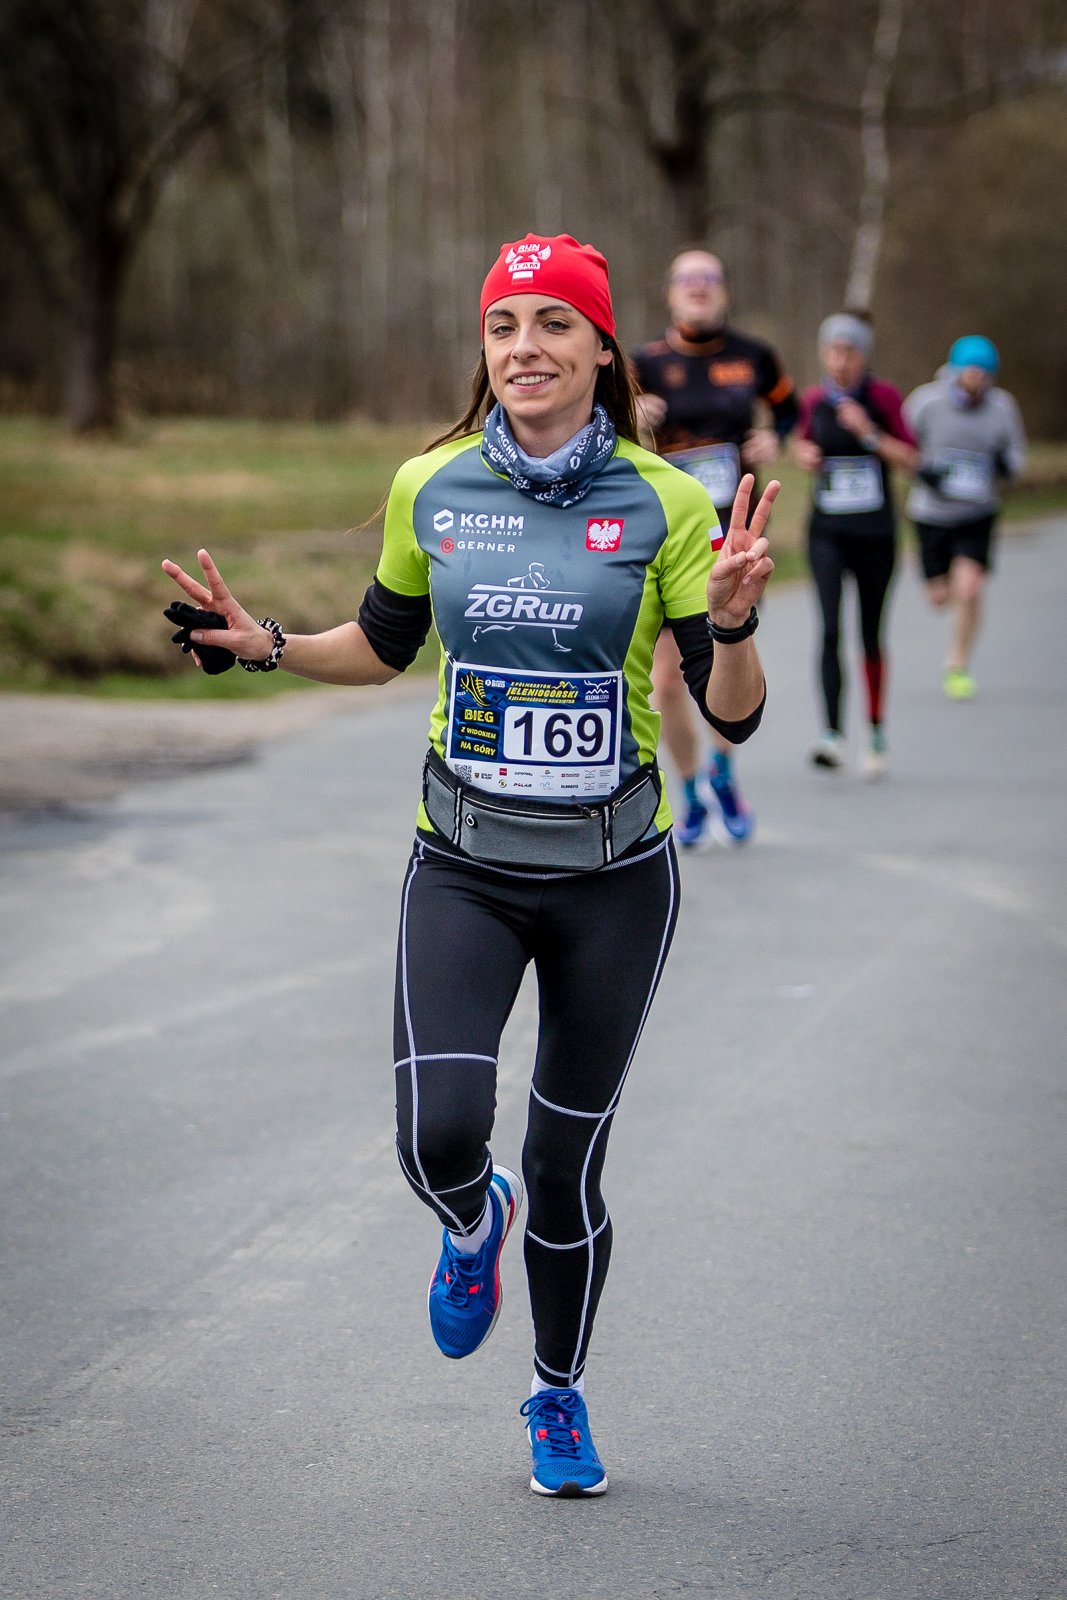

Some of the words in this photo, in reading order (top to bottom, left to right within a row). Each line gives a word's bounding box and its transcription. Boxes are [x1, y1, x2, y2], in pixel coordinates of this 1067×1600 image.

[517, 244, 540, 253] RUN
[460, 514, 524, 529] KGHM
[457, 540, 516, 553] GERNER
[464, 593, 584, 621] ZGRun
[506, 687, 579, 699] JELENIOGÓRSKI
[464, 709, 494, 723] BIEG
[466, 727, 497, 739] WIDOKIEM
[514, 711, 604, 758] 169
[460, 740, 472, 750] NA
[473, 743, 496, 756] GÓRY
